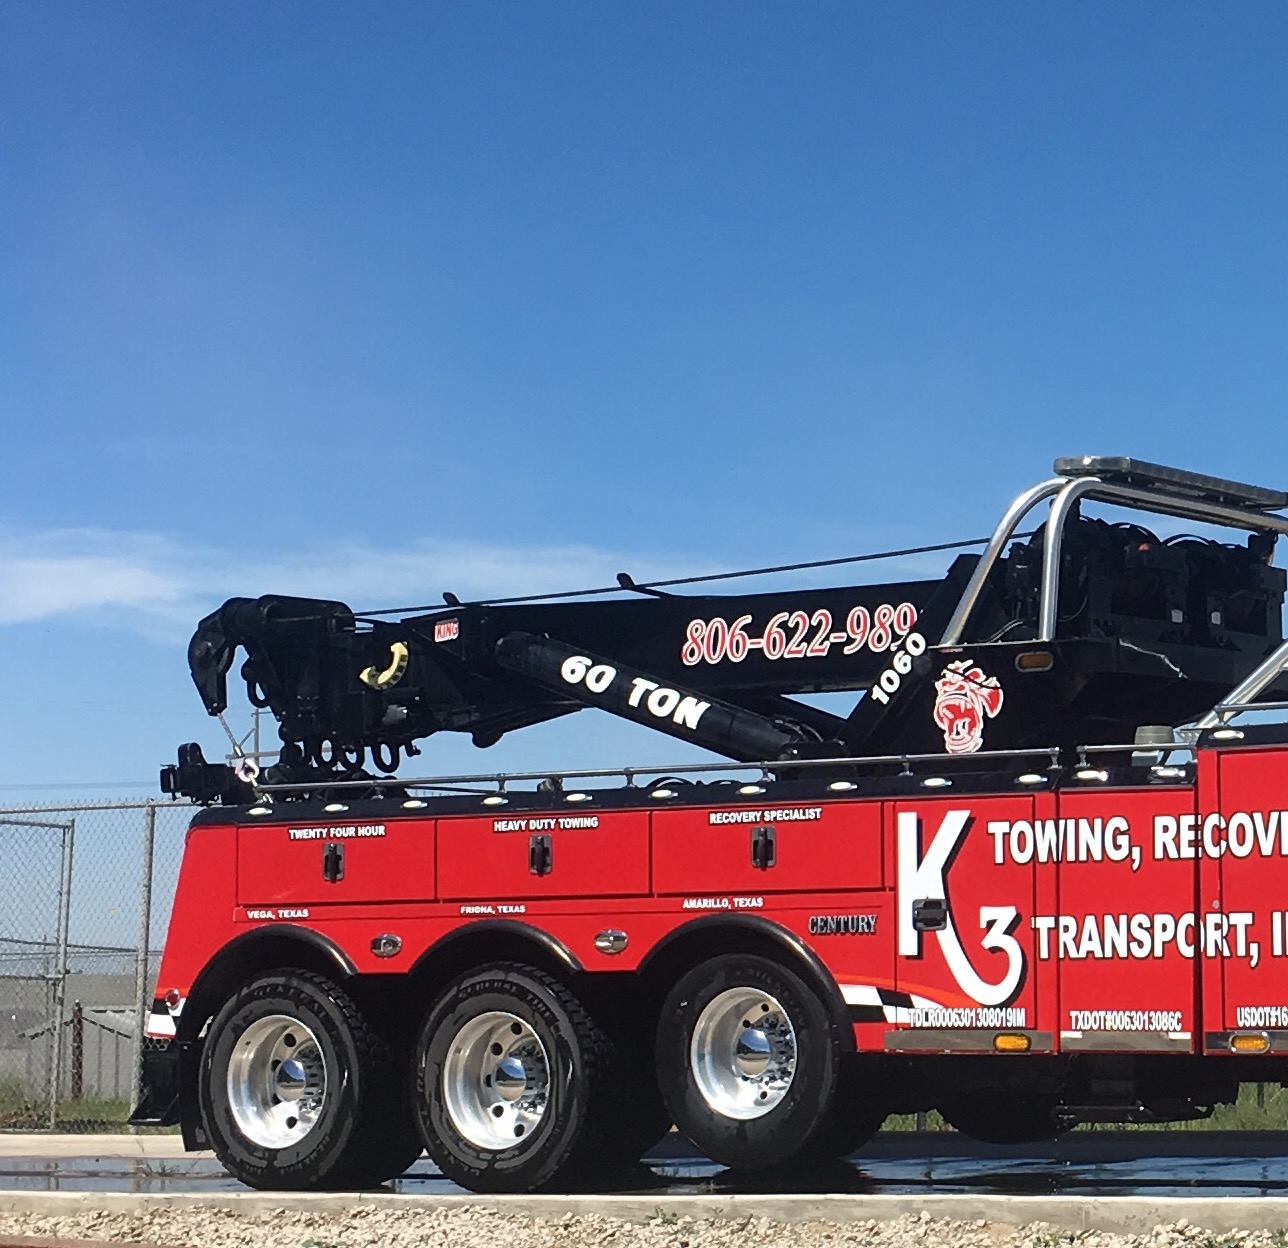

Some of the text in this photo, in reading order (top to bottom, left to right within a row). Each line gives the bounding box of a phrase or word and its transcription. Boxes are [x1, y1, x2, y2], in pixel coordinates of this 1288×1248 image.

[434, 621, 460, 642] KING
[871, 632, 926, 706] 1060
[561, 655, 711, 730] 60 TON
[494, 816, 599, 832] HEAVY DUTY TOWING
[709, 807, 823, 824] RECOVERY SPECIALIST
[289, 825, 386, 840] TWENTY FOUR HOUR
[987, 816, 1142, 872] TOWING,
[460, 904, 526, 915] FRIONA, TEXAS
[682, 896, 764, 910] AMARILLO, TEXAS
[246, 908, 309, 920] VEGA, TEXAS
[808, 914, 878, 934] CENTURY
[1031, 912, 1260, 969] TRANSPORT,
